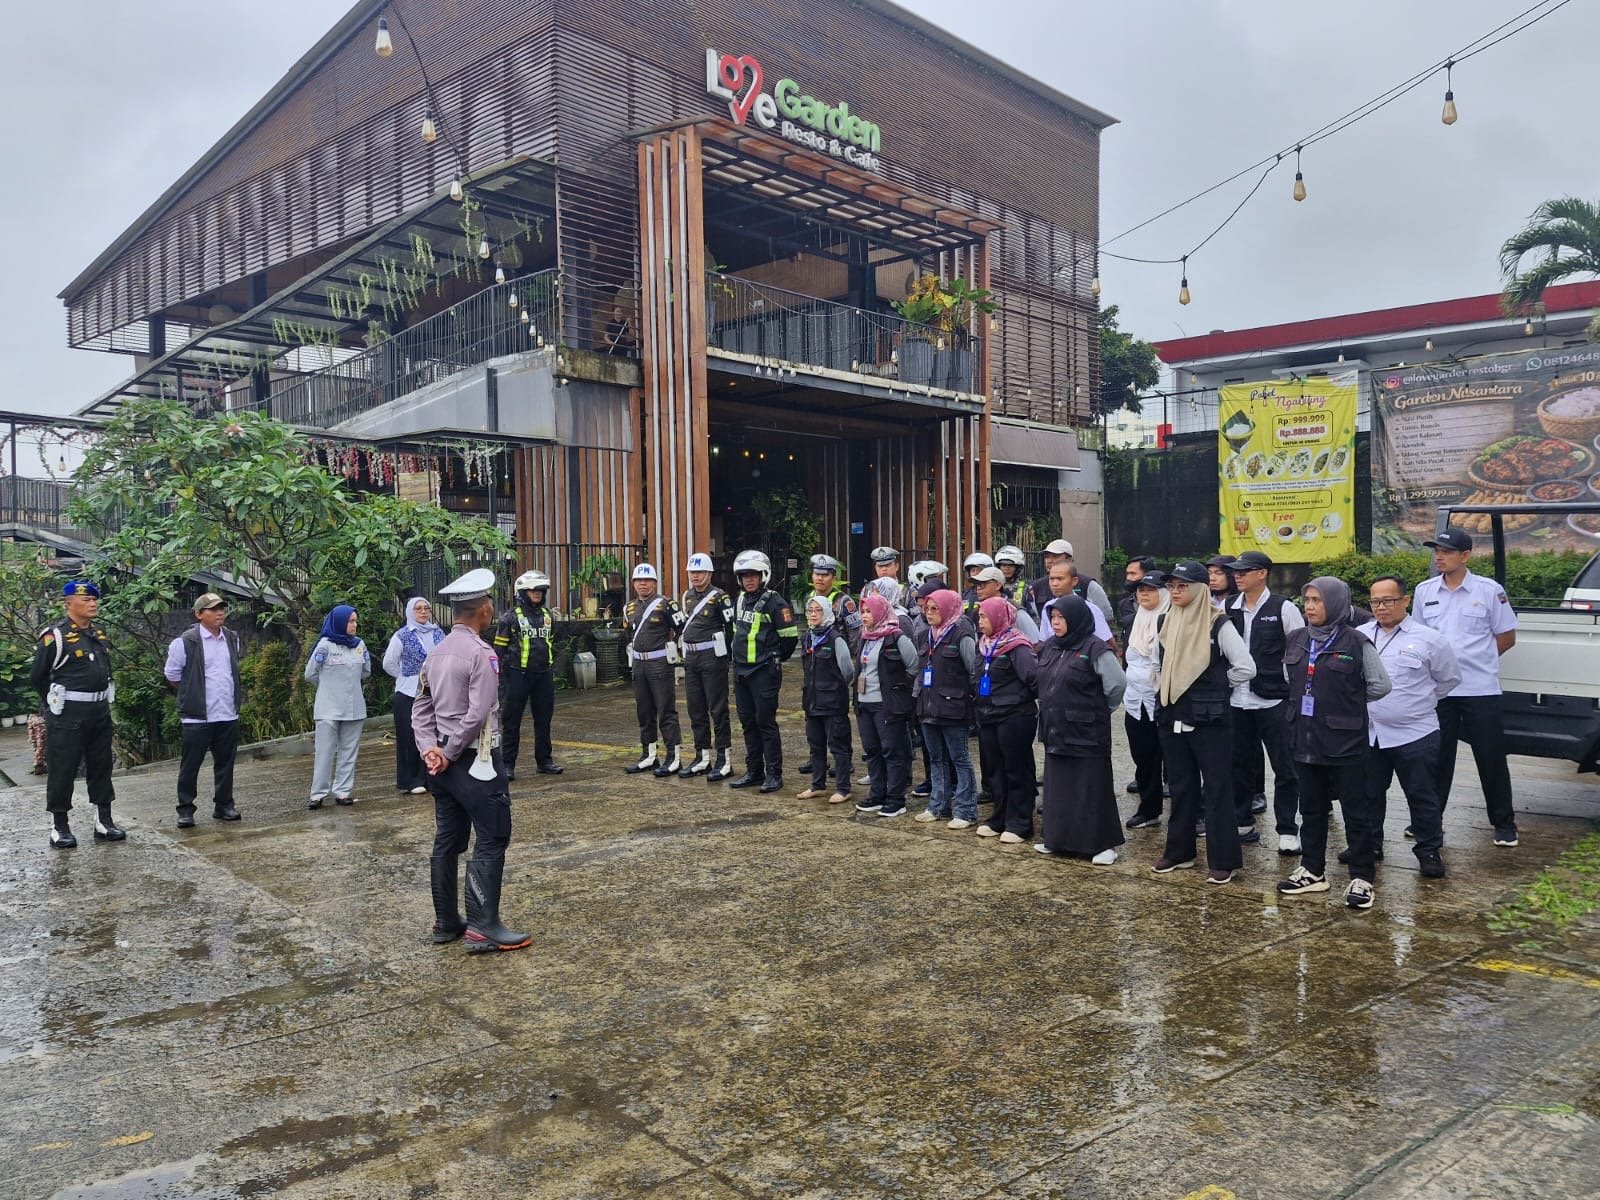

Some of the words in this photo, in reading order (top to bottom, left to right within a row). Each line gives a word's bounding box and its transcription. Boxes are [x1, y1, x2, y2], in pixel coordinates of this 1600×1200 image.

[706, 49, 777, 129] Love
[774, 78, 881, 152] Garden
[781, 121, 826, 150] Resto
[829, 140, 842, 157] &
[845, 146, 880, 171] Cafe
[1581, 371, 1595, 382] 10
[1394, 390, 1446, 409] Garden
[1447, 385, 1522, 401] Nusantara
[1272, 512, 1295, 522] Free
[637, 566, 650, 574] PM
[689, 557, 701, 567] PM
